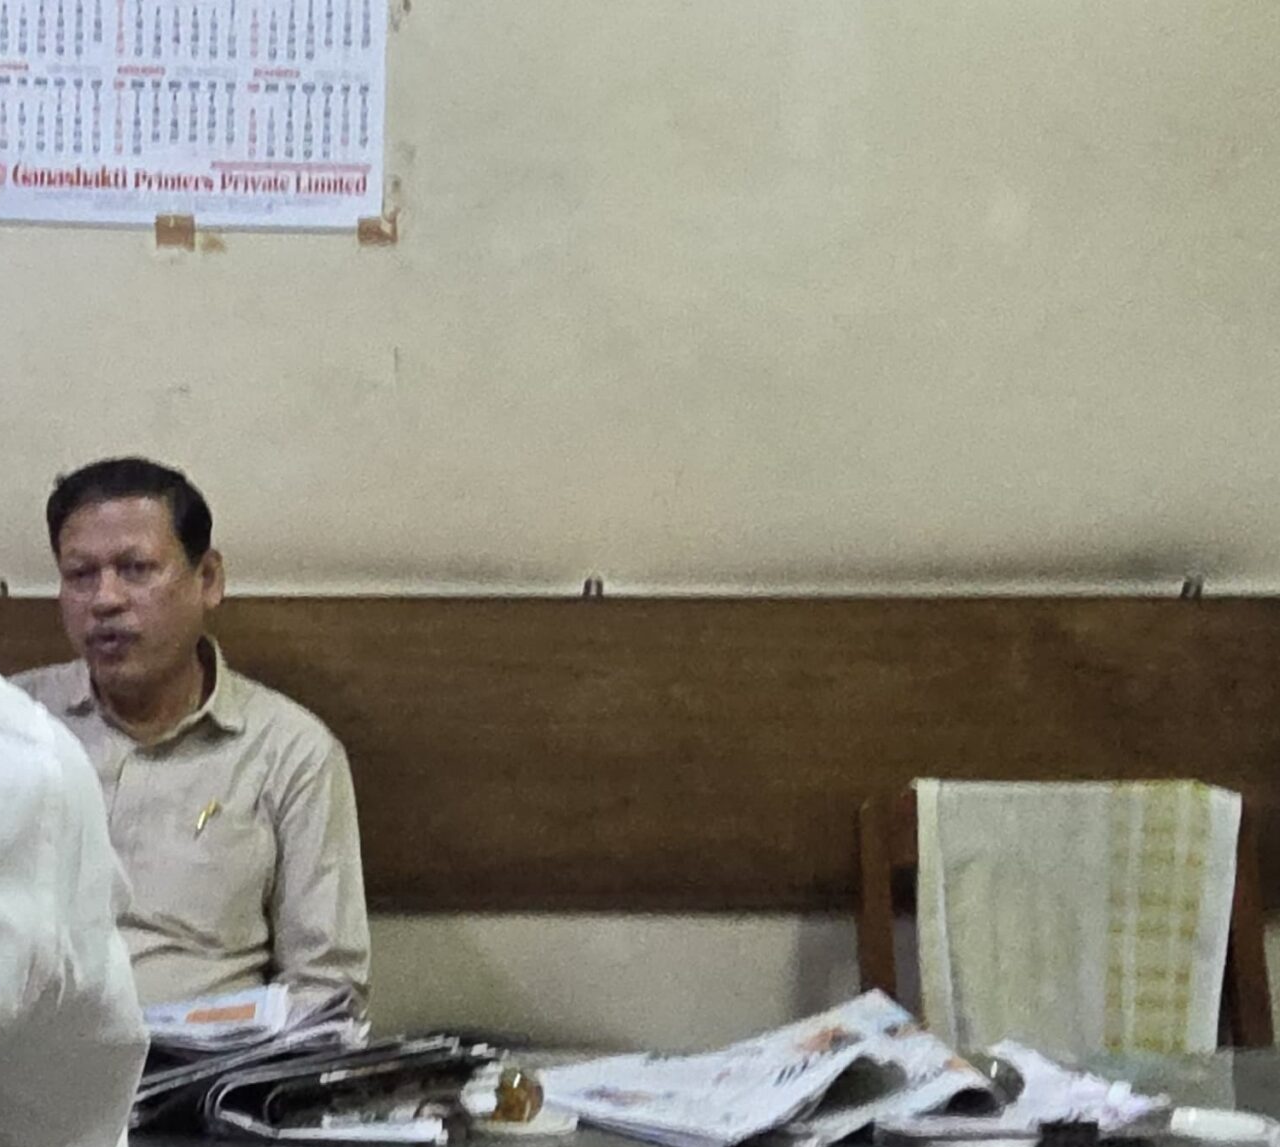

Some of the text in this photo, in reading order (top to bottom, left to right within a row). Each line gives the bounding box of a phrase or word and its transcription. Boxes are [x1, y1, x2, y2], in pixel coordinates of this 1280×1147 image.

[134, 170, 214, 192] Printers
[220, 173, 289, 194] Private
[295, 173, 367, 195] Limited
